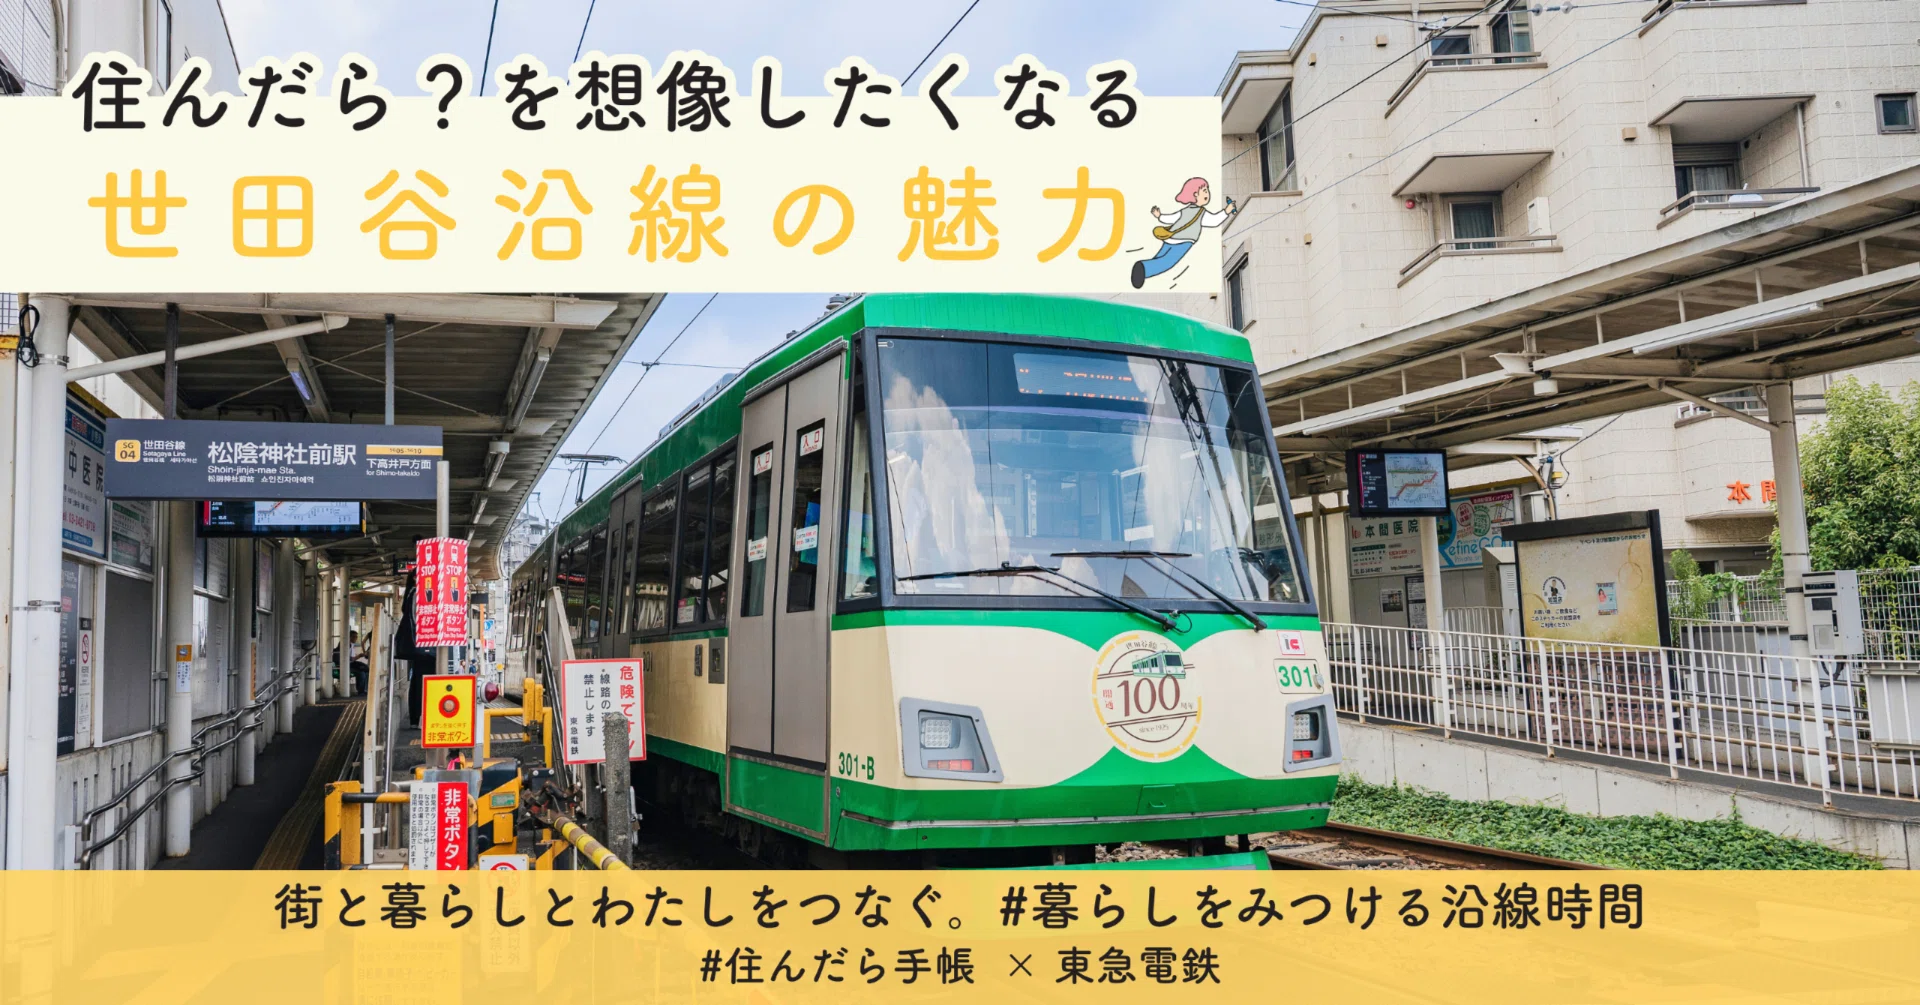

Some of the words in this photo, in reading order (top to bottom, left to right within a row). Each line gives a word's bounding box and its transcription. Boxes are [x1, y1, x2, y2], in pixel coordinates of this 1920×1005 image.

[143, 440, 186, 450] 世田谷線
[803, 430, 820, 448] 入口
[120, 450, 136, 460] 04
[208, 441, 356, 466] 松陰神社前駅
[756, 452, 770, 467] 入口
[279, 466, 296, 474] Sta.
[366, 458, 432, 470] 下高井戸方面
[1365, 518, 1418, 538] 本間医院
[421, 565, 436, 576] STOP
[446, 565, 462, 576] STOP
[421, 616, 435, 626] ボタン
[446, 615, 461, 625] ボタン
[1278, 666, 1312, 687] 301
[1117, 674, 1180, 717] 100
[584, 674, 595, 736] 禁止します
[428, 731, 469, 742] 非常ボタン
[570, 717, 578, 755] 東急電鉄
[838, 752, 875, 780] 301-B
